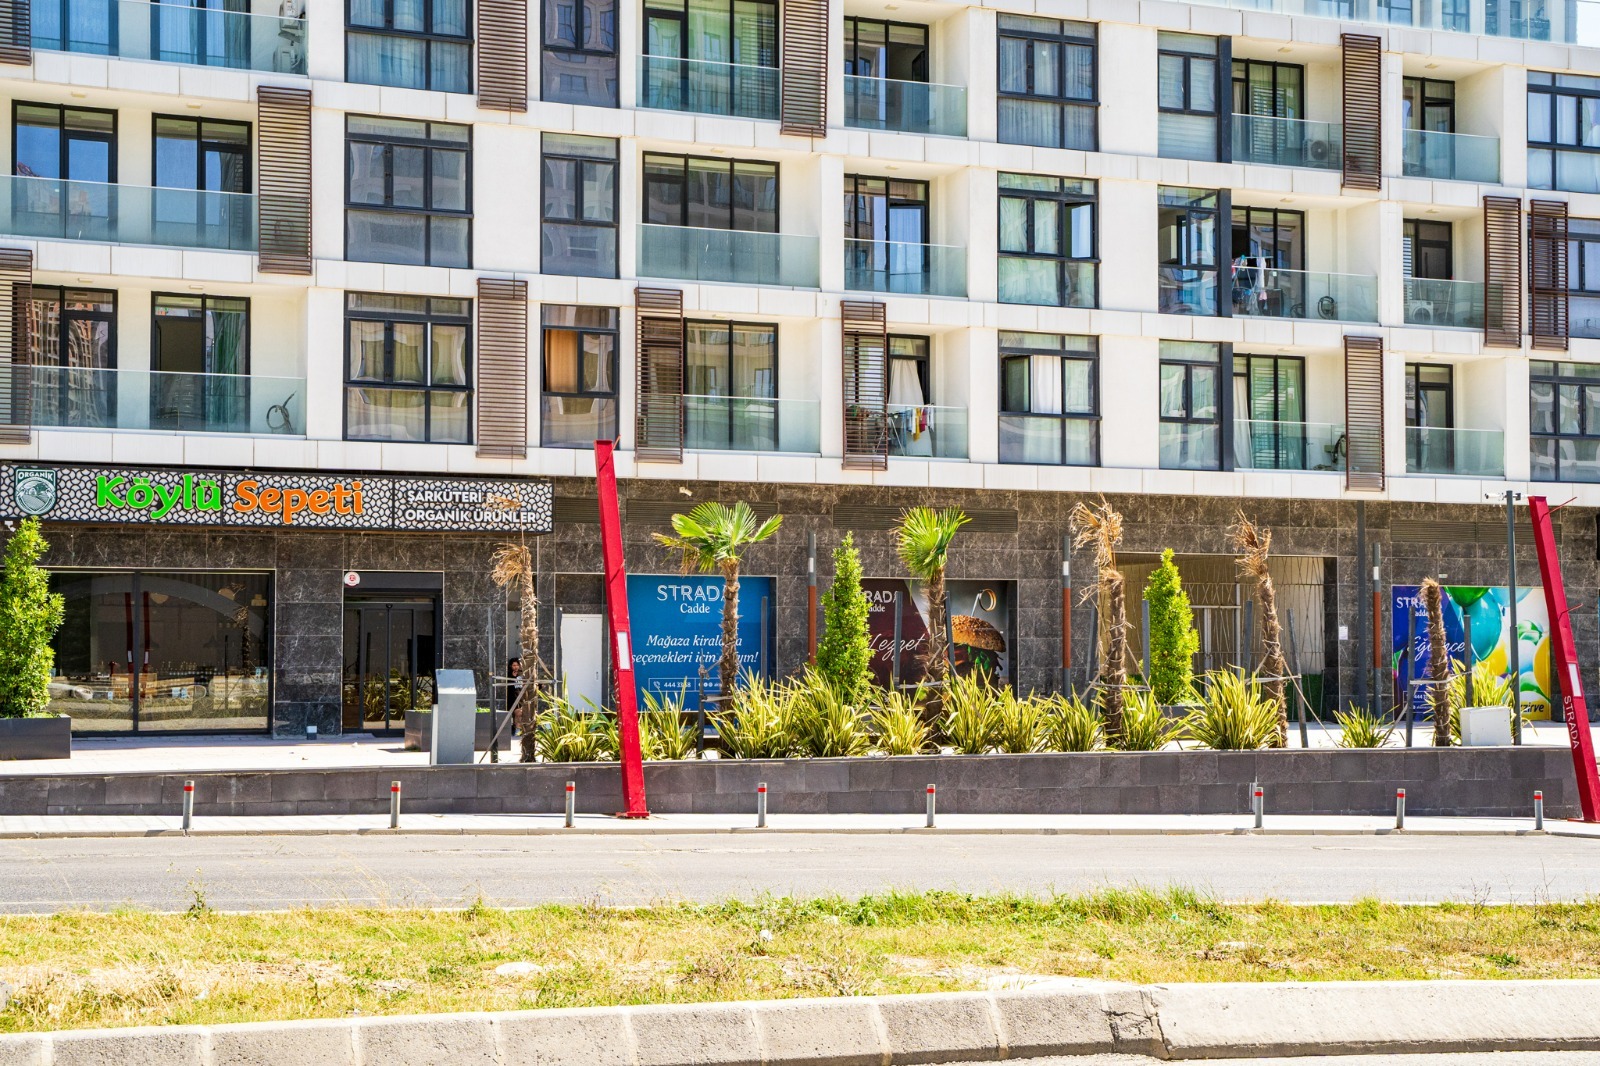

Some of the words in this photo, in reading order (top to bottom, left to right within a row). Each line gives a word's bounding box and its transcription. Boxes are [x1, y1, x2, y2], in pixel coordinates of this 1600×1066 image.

[18, 471, 54, 481] ORGANİK
[95, 474, 223, 519] Köylü
[233, 480, 363, 524] Sepeti
[407, 489, 482, 505] ŞARKÜTERİ
[405, 507, 470, 522] ORGANİK
[473, 508, 536, 523] ÜRÜNLER
[680, 602, 710, 614] Cadde
[868, 603, 885, 612] adde
[646, 634, 690, 649] Mağaza
[632, 651, 693, 666] seçenekleri
[1563, 695, 1580, 750] STRADA
